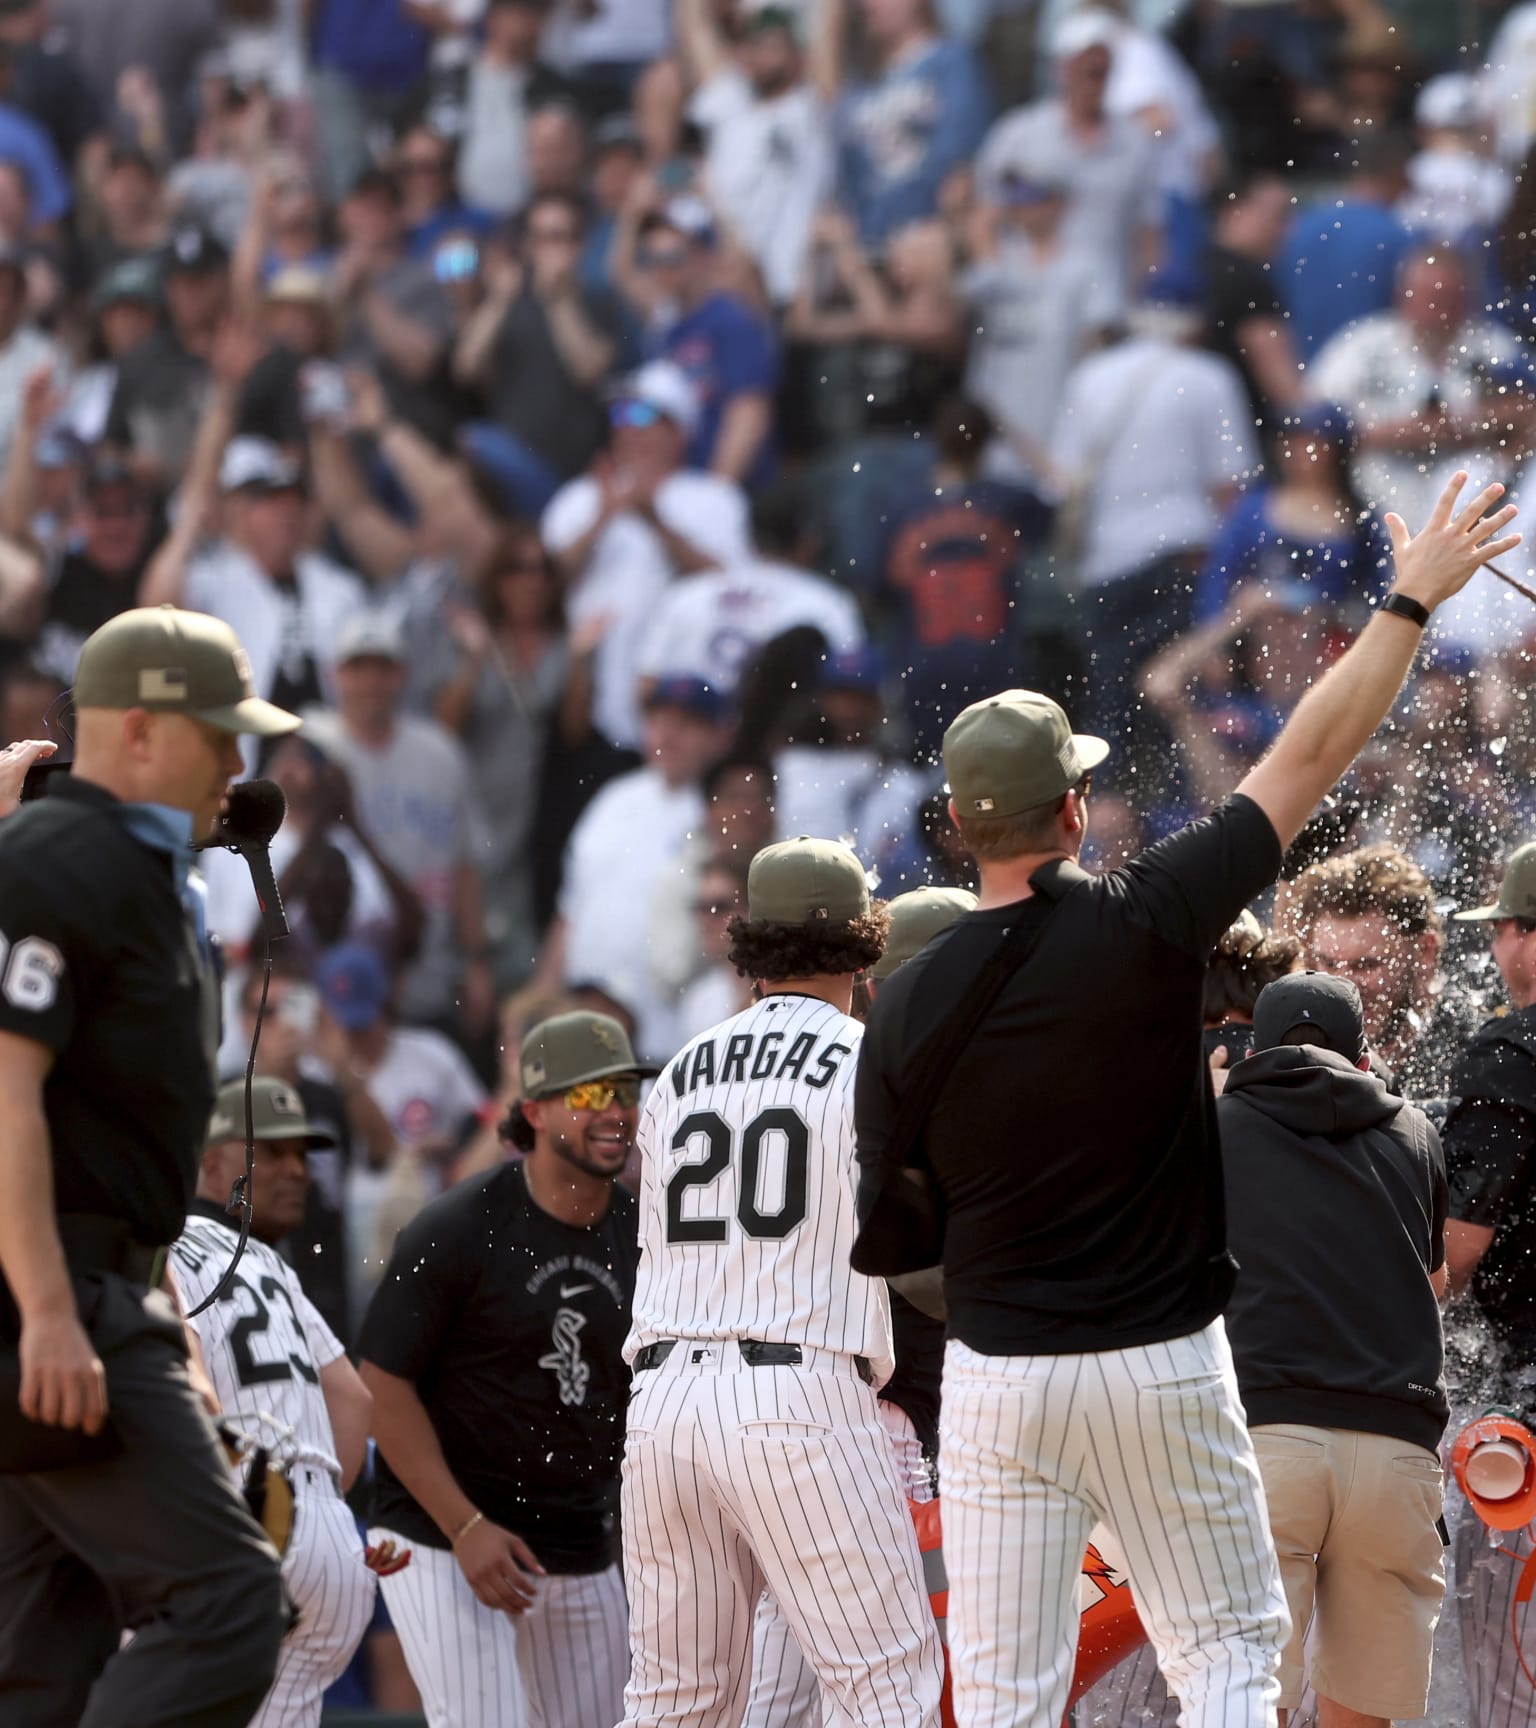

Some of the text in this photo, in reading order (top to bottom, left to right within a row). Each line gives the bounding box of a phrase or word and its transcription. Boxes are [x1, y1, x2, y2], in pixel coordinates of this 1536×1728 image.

[0, 932, 65, 1011] 6
[671, 1032, 852, 1098] VARGAS
[666, 1105, 814, 1247] 20
